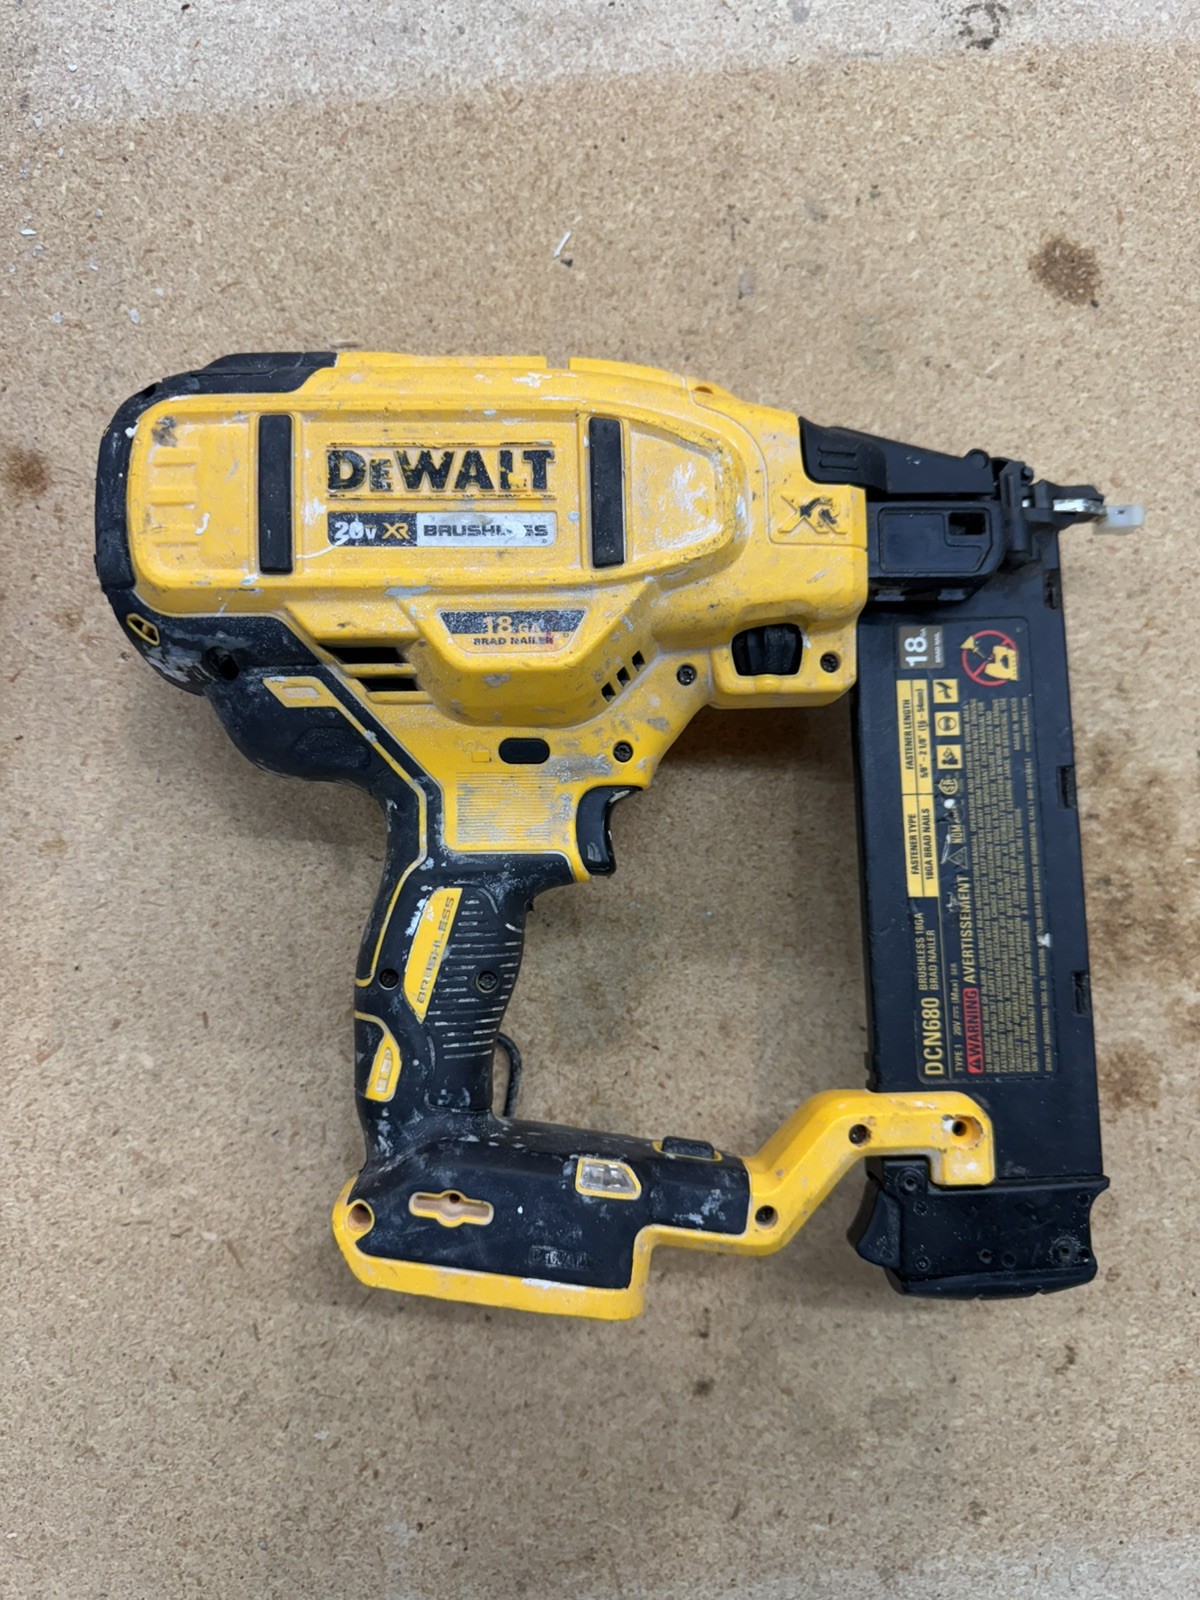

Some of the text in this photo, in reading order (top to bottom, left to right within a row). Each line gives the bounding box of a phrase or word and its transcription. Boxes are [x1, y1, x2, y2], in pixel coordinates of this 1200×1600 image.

[327, 449, 556, 492] DEWALT
[381, 522, 411, 540] XR
[473, 636, 507, 646] BRAD
[903, 636, 928, 666] 18
[902, 699, 914, 769] FASTENER LENGTH
[907, 813, 919, 874] FASTENER TYPE
[921, 808, 933, 879] 18GA BRAD NAILS
[416, 896, 456, 1004] BRUSHLESS
[913, 913, 927, 990] BRUSHLESS 18GA
[925, 929, 938, 990] BRAD NAILER
[956, 874, 981, 1056] WARNING AVERTISSEMENT
[949, 979, 959, 1003] (Max)
[920, 996, 944, 1075] DCN680
[952, 1020, 961, 1035] 20V
[954, 1050, 963, 1071] TYPE
